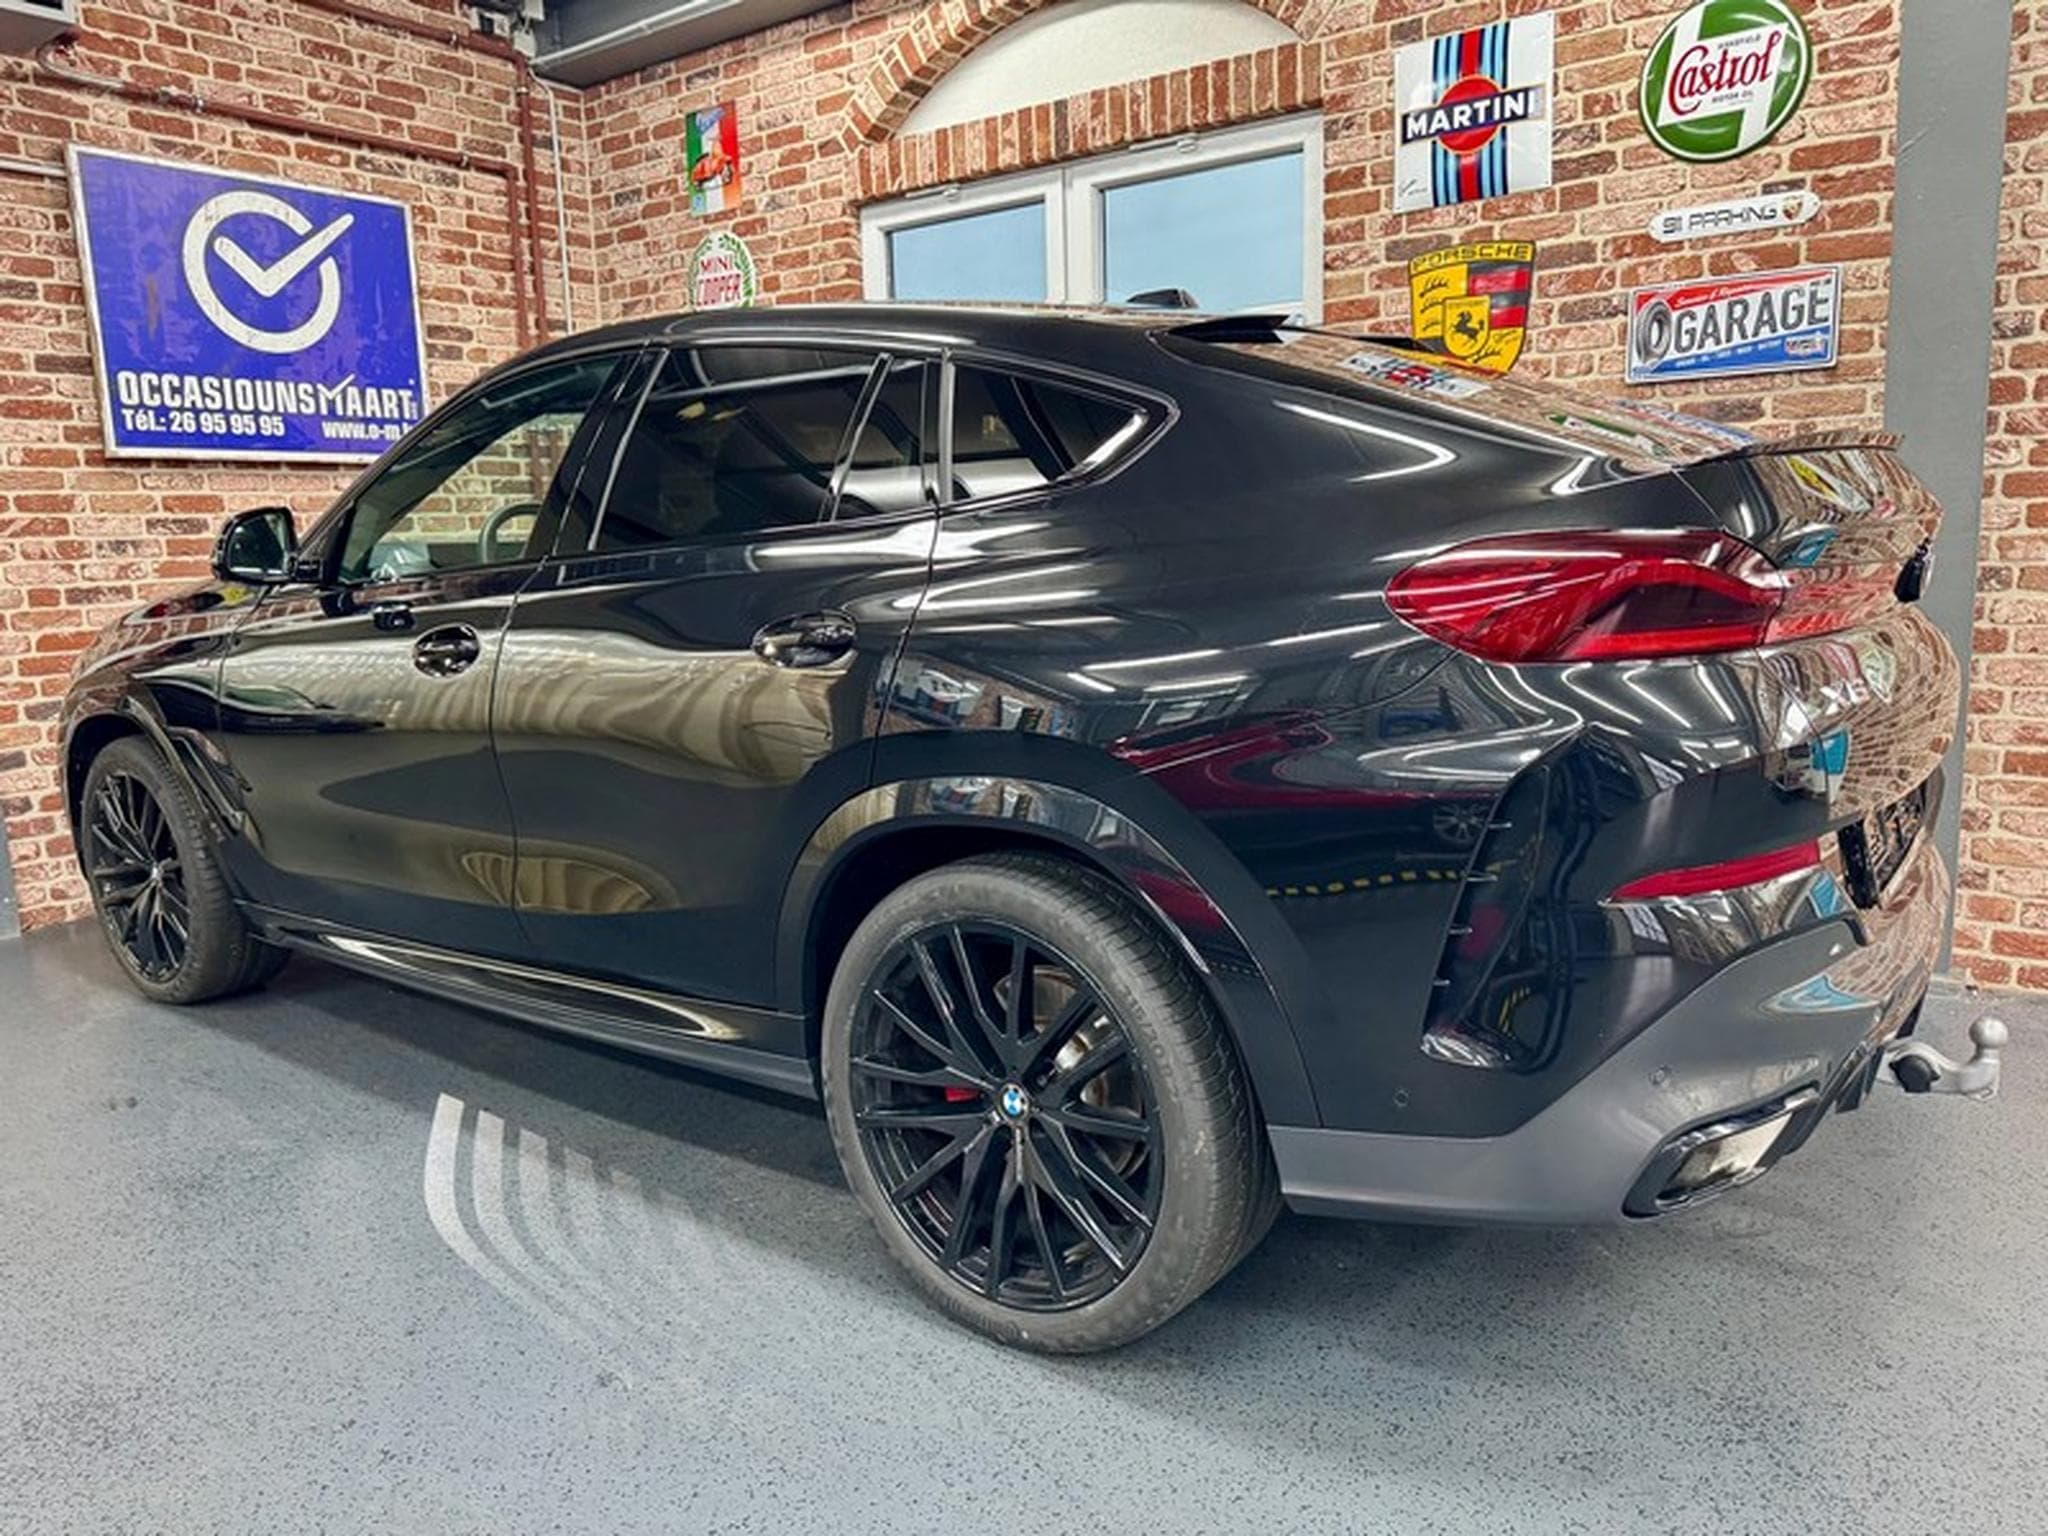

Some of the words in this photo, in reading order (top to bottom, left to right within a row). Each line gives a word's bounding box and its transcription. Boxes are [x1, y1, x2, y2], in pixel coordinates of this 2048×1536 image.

[1669, 30, 1782, 116] Castrol
[1406, 90, 1536, 140] MARTINI
[1688, 204, 1778, 231] PARKING
[701, 254, 733, 273] MINI
[1412, 244, 1530, 272] PORSCHE
[697, 273, 741, 306] COOPER
[1673, 278, 1832, 354] GARAGE
[169, 410, 197, 434] 26
[200, 411, 227, 435] 95
[230, 413, 257, 436] 95
[260, 415, 285, 437] 95
[1819, 678, 1870, 715] X6
